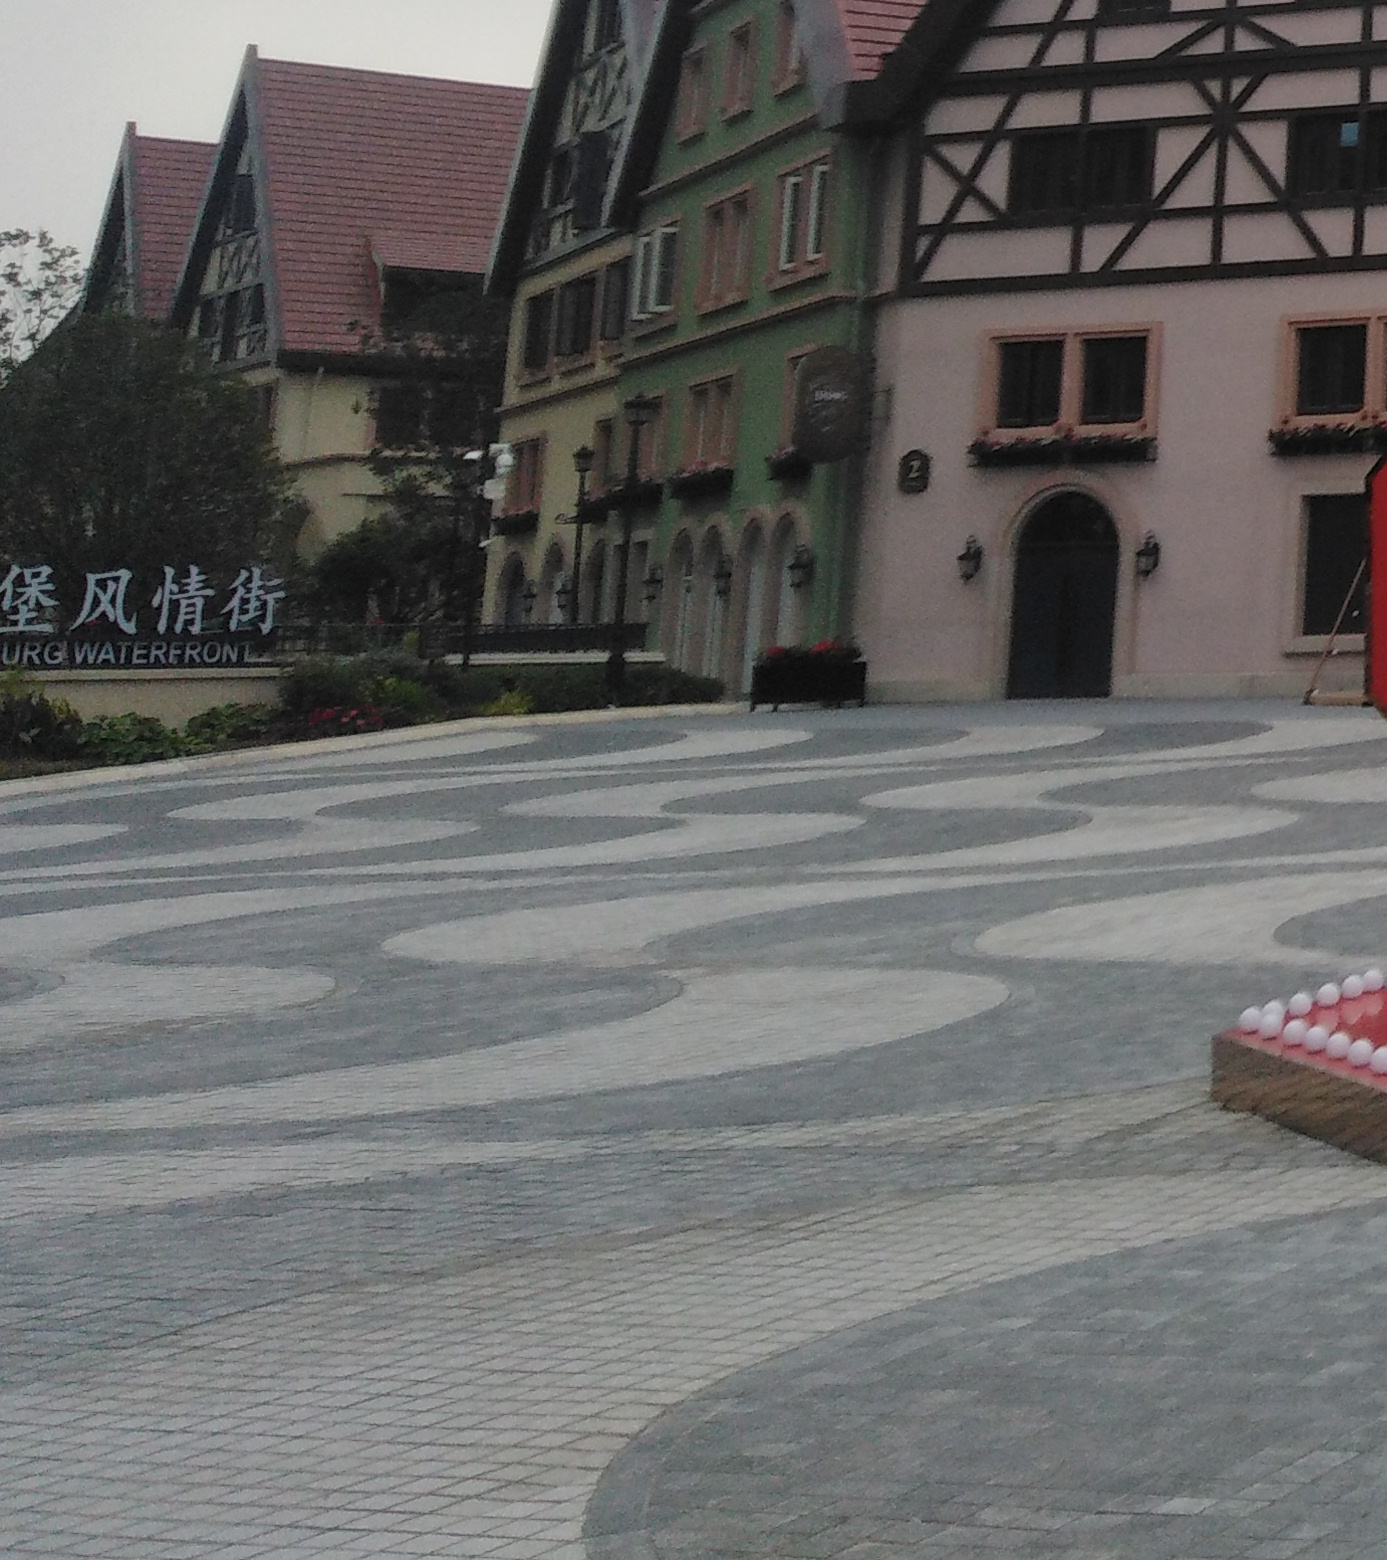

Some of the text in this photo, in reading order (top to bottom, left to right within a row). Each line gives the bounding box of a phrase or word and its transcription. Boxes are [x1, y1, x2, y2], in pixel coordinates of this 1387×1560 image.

[908, 460, 922, 479] 2
[0, 563, 287, 635] 堡风情街
[74, 641, 258, 665] WATERFRONT
